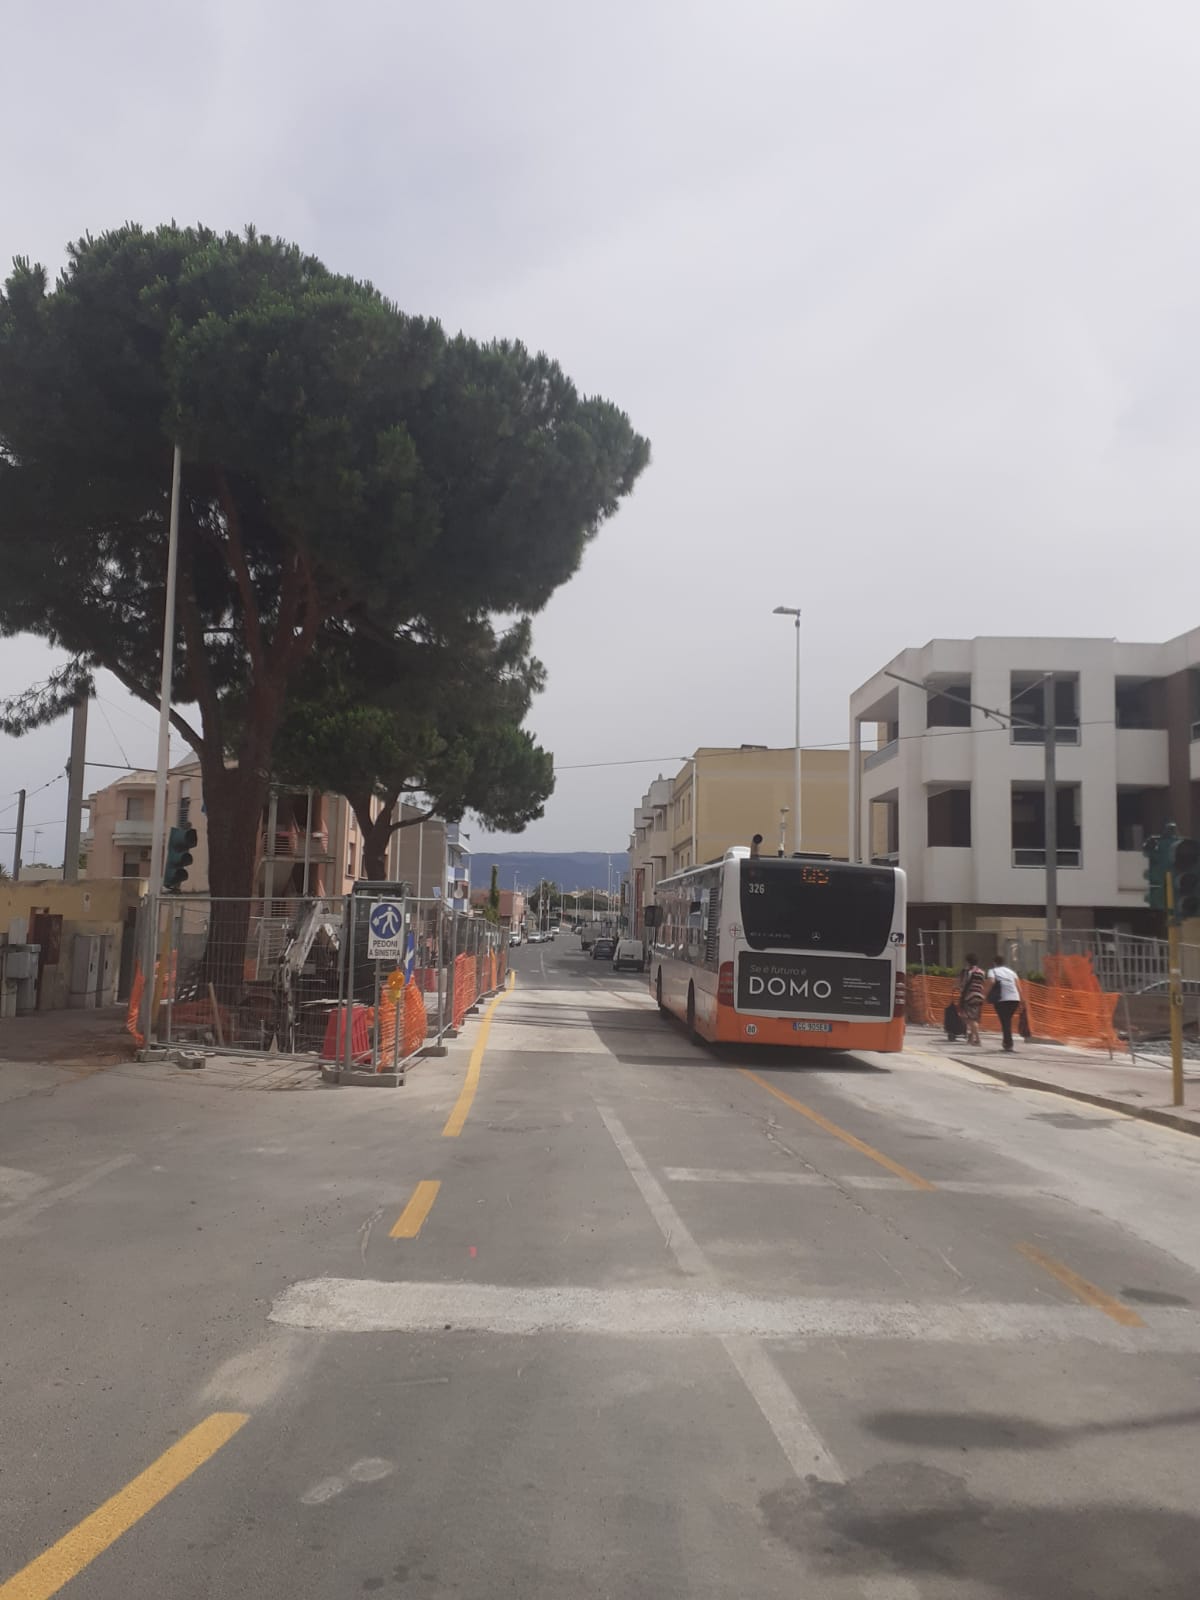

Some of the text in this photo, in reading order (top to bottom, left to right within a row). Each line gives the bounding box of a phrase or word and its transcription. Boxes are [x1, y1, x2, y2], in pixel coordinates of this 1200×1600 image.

[748, 883, 765, 894] 326
[372, 940, 398, 948] PEDONI
[749, 976, 832, 999] DOMO
